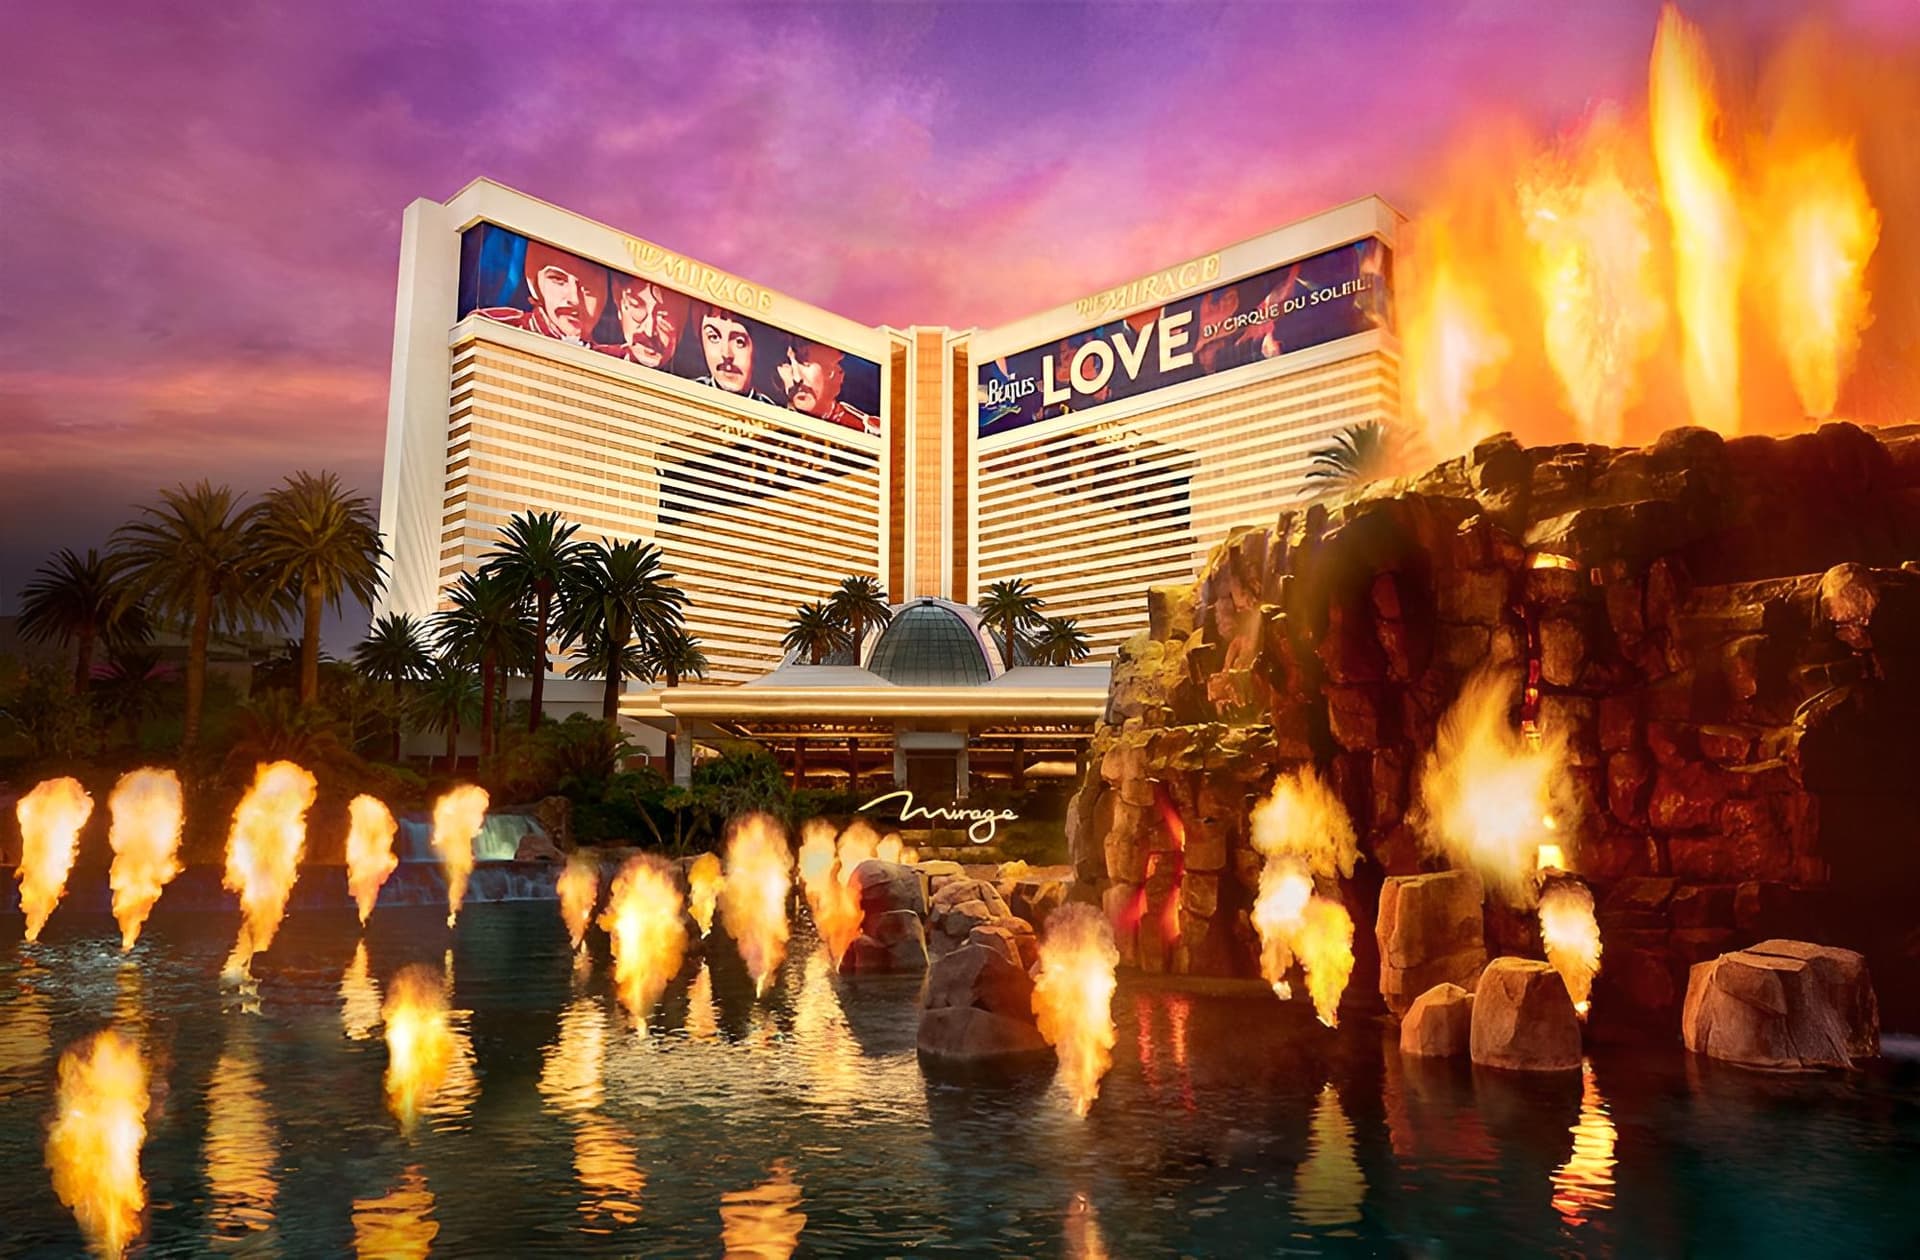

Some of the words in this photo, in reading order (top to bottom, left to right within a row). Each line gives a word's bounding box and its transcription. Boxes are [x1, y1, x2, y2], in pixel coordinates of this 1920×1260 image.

[660, 255, 773, 314] MIRAGE
[1223, 306, 1280, 332] CIRQUE
[1283, 295, 1305, 314] DU
[1042, 310, 1193, 407] LOVE
